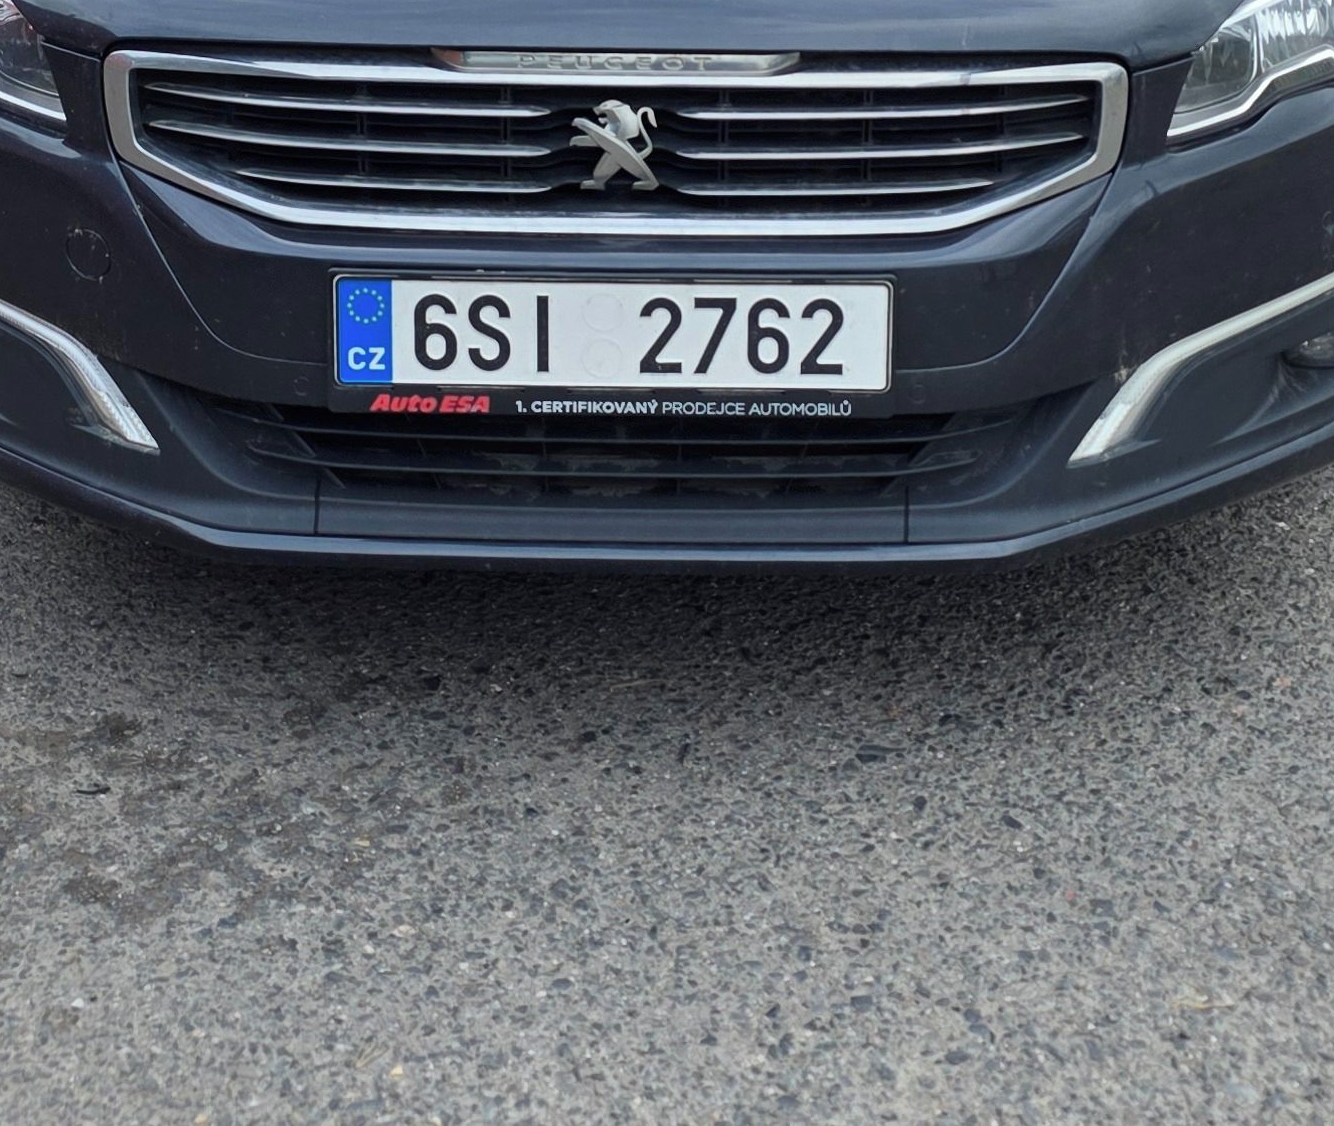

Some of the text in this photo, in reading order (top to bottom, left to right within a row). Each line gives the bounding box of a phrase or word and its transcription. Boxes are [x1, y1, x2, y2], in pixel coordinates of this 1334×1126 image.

[517, 54, 712, 72] PEUGEOT
[413, 294, 845, 375] 6SI 2762
[347, 347, 386, 371] CZ
[369, 393, 491, 414] Auto ESA
[515, 398, 852, 416] 1. CERTIFIKOVANÝ PRODEJCE AUTOMOBILŮ
